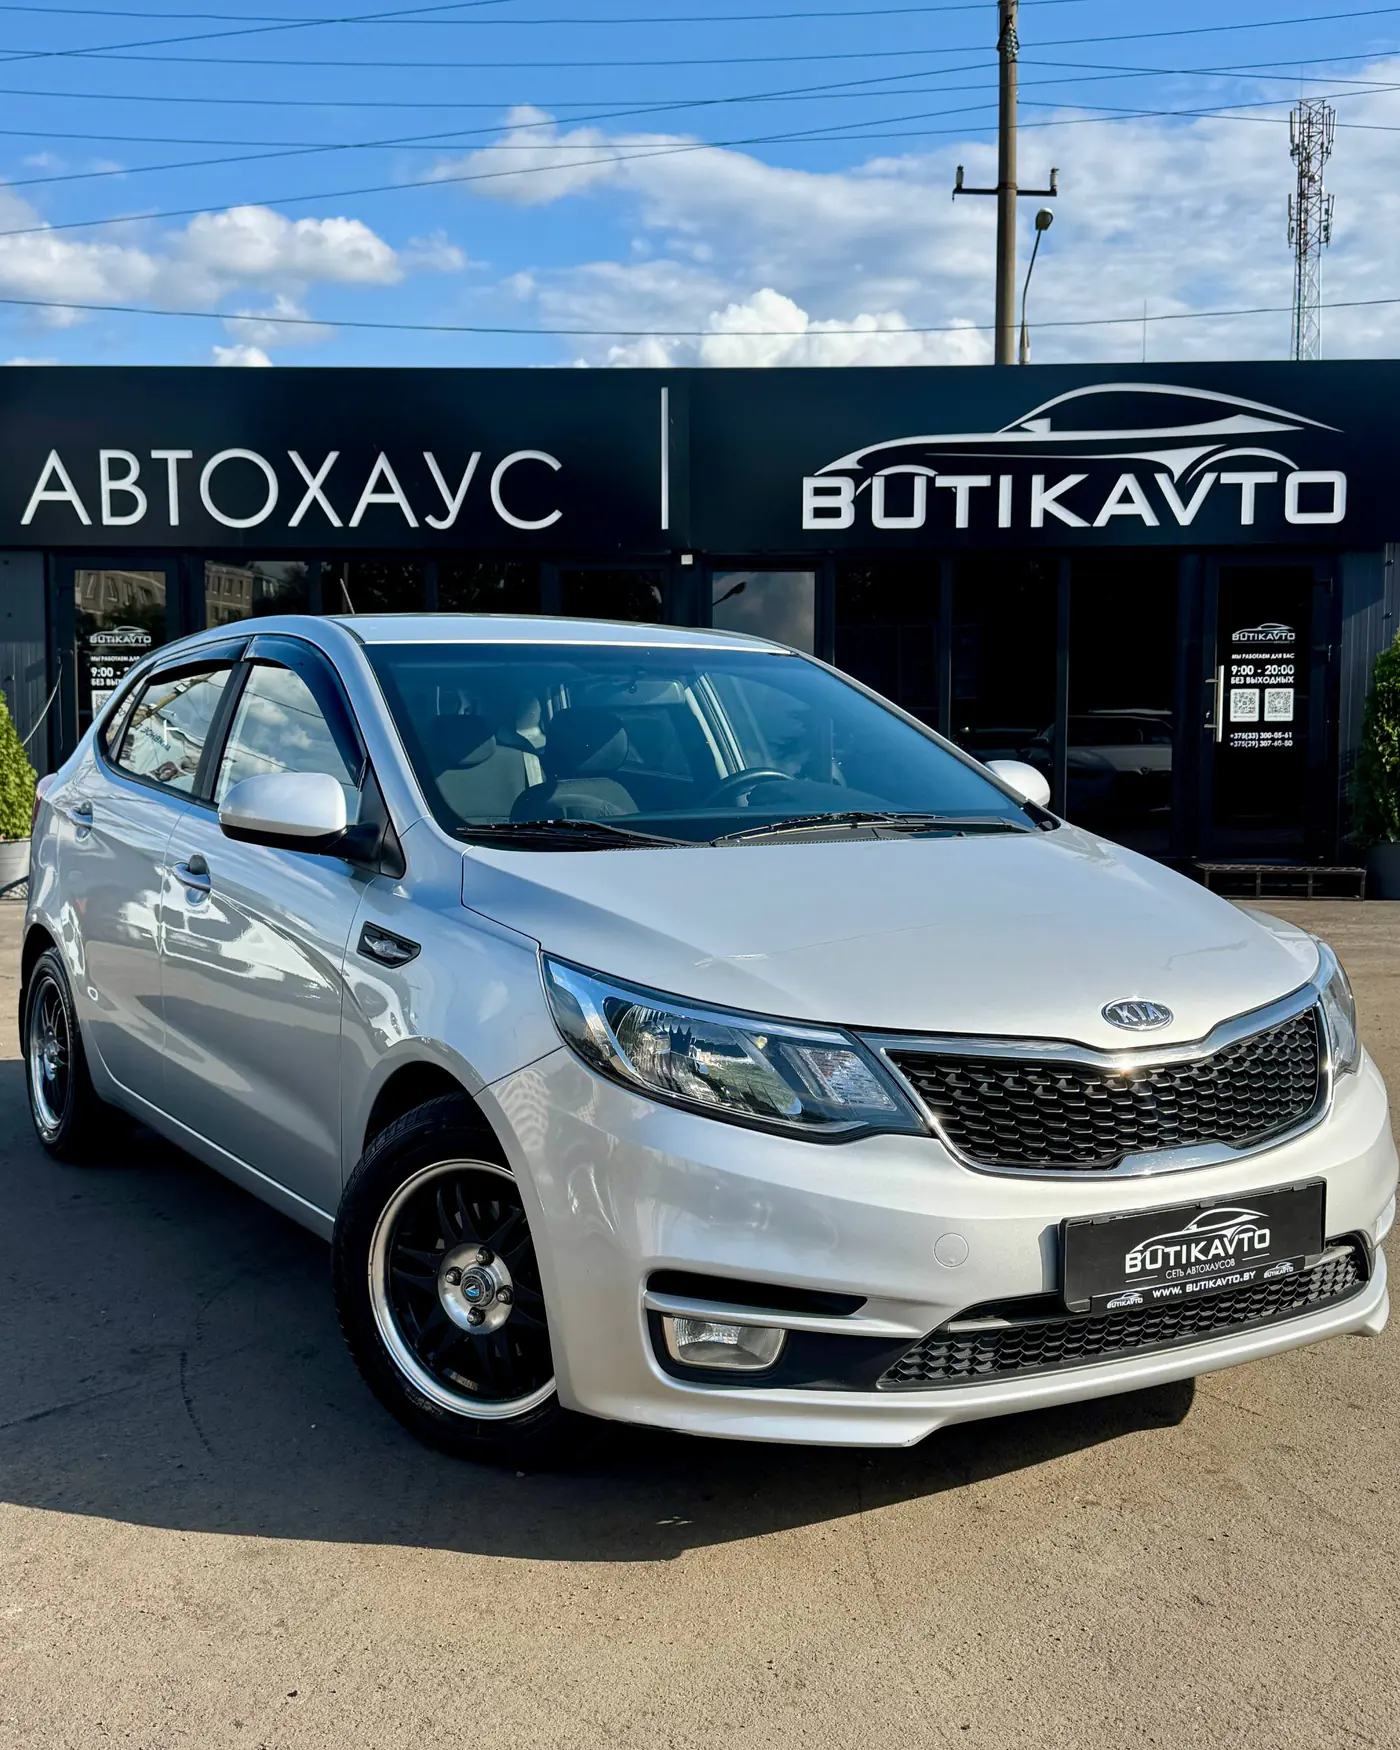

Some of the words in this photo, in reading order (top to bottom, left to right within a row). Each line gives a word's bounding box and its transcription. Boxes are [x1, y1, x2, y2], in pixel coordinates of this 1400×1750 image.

[20, 448, 563, 530] АВТОХАУС
[802, 469, 1348, 530] BUTIKAVTO
[89, 635, 152, 643] BUTIKAVTO
[1232, 633, 1296, 641] BUTIKAVTO
[91, 667, 114, 677] 9:00
[1231, 665, 1255, 675] 9:00
[1264, 664, 1295, 675] 20:00
[91, 678, 105, 687] БЕЗ
[1230, 676, 1244, 684] БЕЗ
[1246, 676, 1295, 684] ВЫХОДНЫХ
[1112, 1003, 1165, 1023] KIA
[1125, 1228, 1271, 1274] BUTIKAVTO
[1165, 1267, 1185, 1279] СЕТЬ
[1186, 1258, 1236, 1276] АВТОХАУСОВ
[1264, 1266, 1294, 1279] BUTIKAVTO
[1186, 1270, 1257, 1293] BUTIKAVTO.BY
[1106, 1297, 1144, 1309] BUTIKAVTO
